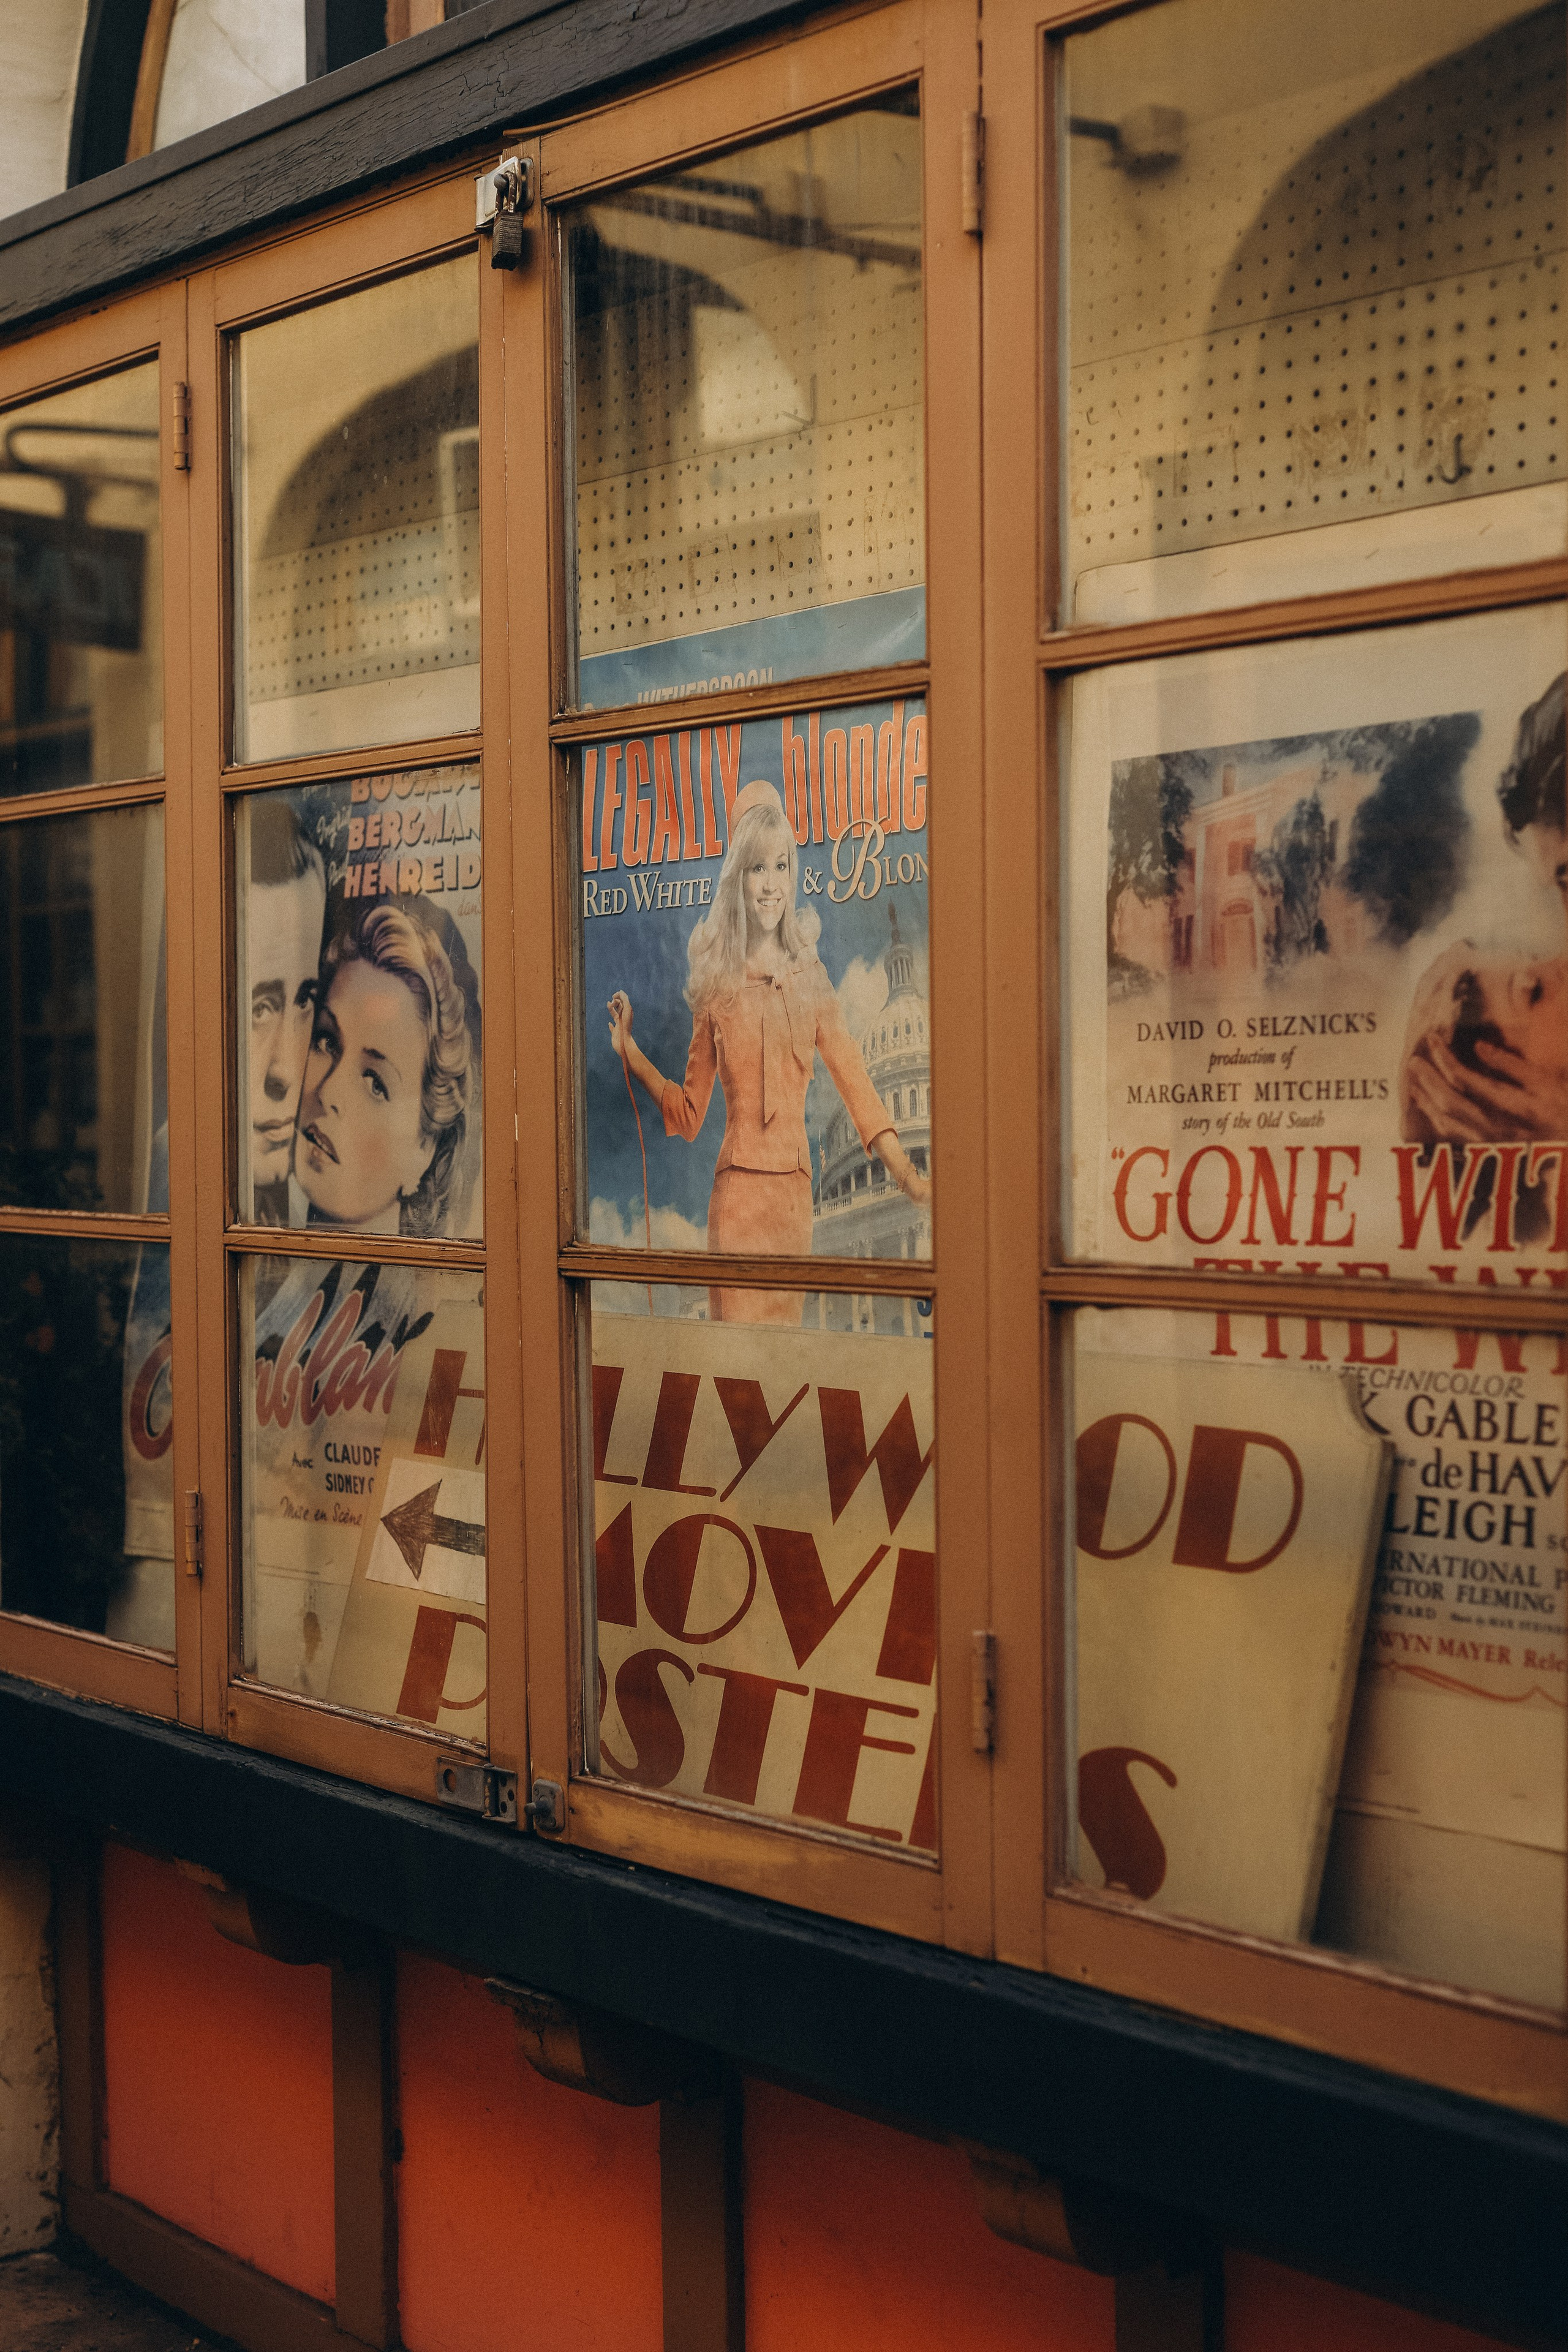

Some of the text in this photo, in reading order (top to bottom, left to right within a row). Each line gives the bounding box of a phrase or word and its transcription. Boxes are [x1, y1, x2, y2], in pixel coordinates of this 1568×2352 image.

[582, 699, 928, 873] LEGALLY blonde
[348, 801, 481, 853] BERGMAN
[344, 854, 481, 899] HENREID
[803, 866, 824, 894] &
[1137, 1012, 1378, 1041] DAVID O. SELZNICK'S
[1208, 1046, 1297, 1073] production of
[1127, 1079, 1390, 1104] MARGARET MITCHELL'S
[1182, 1110, 1325, 1136] story of the Old South
[1406, 1394, 1561, 1447] GABLE
[325, 1472, 365, 1494] SIDNEY
[1383, 1492, 1536, 1548] LEIGH
[1455, 1583, 1556, 1615] FLEMING
[1438, 1637, 1513, 1665] MAYER
